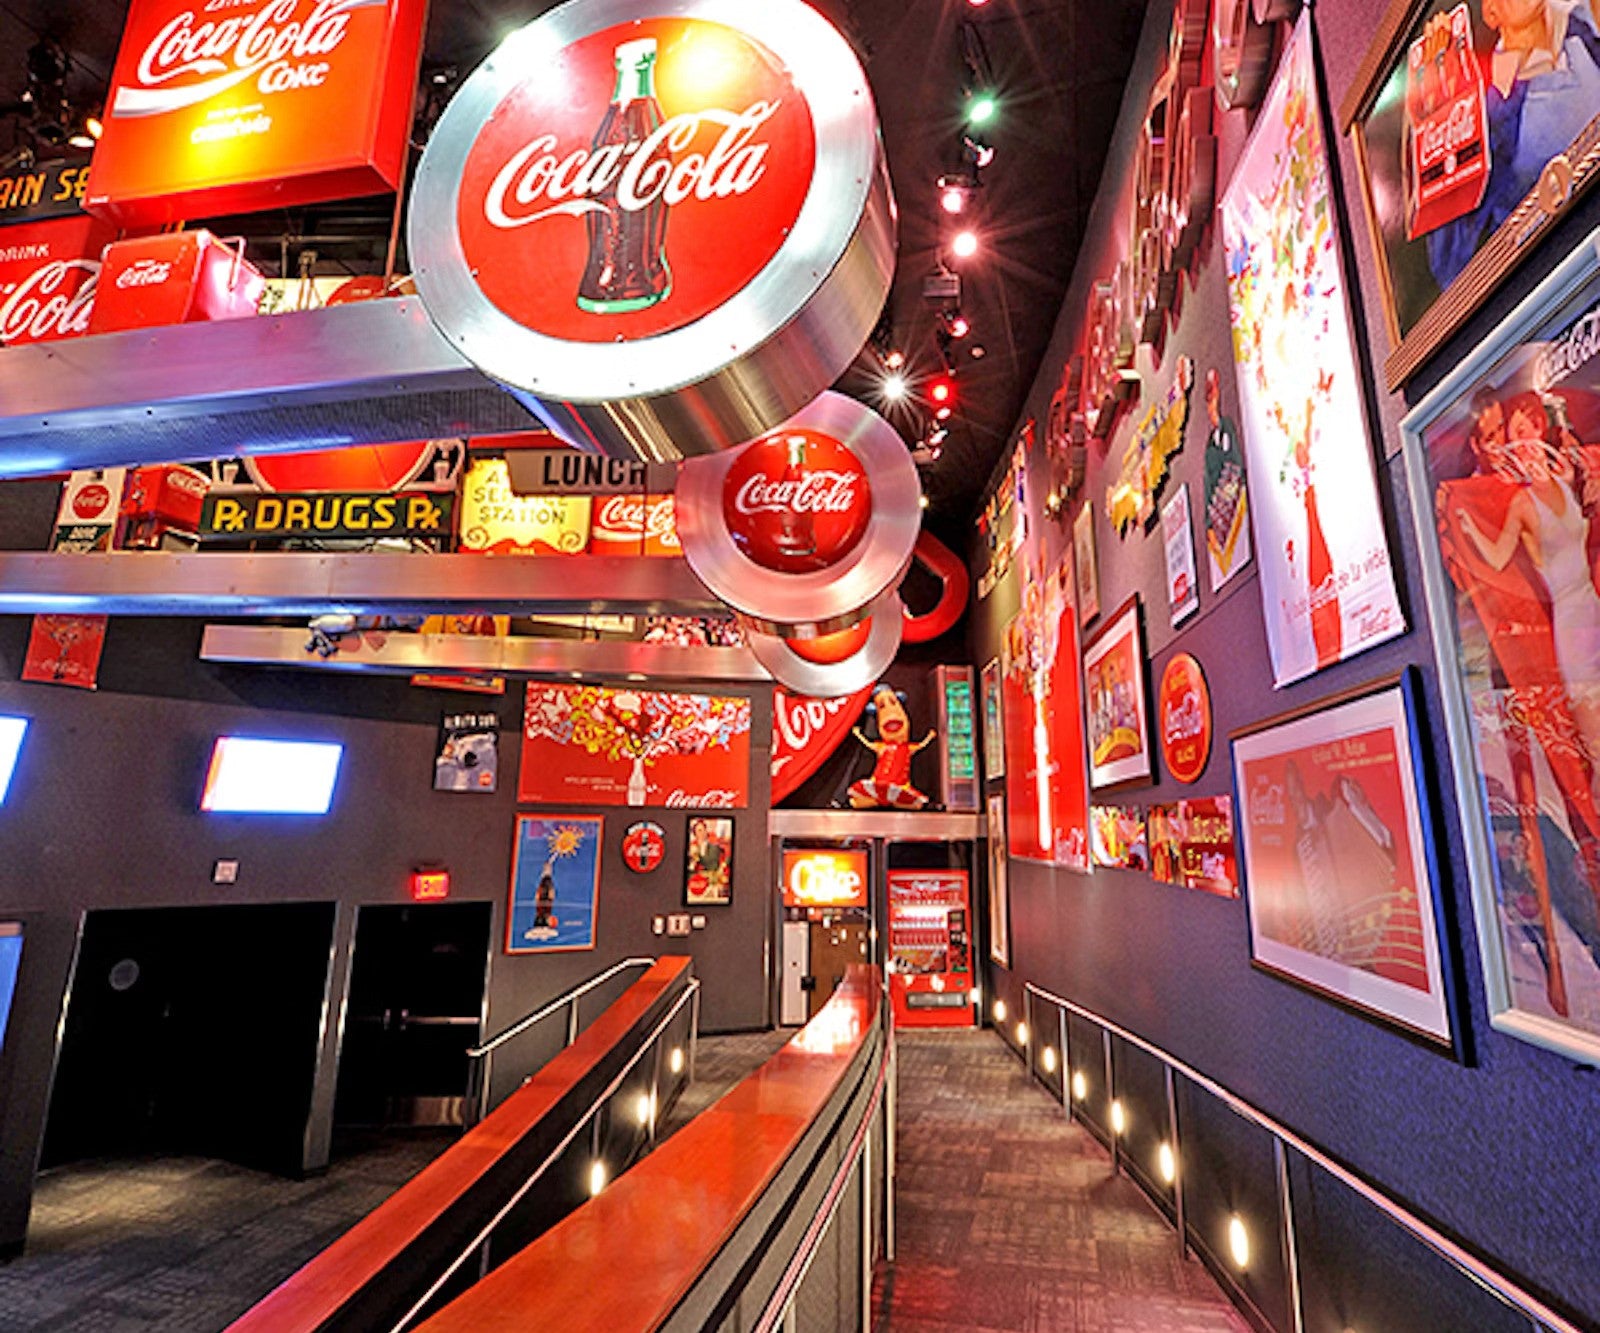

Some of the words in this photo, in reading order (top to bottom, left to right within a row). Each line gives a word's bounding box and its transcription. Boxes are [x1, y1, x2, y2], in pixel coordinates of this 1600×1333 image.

[257, 61, 331, 93] Coke
[484, 98, 782, 228] Coca-Cola
[735, 470, 859, 514] Coca-Cola
[255, 497, 396, 531] DRUGS
